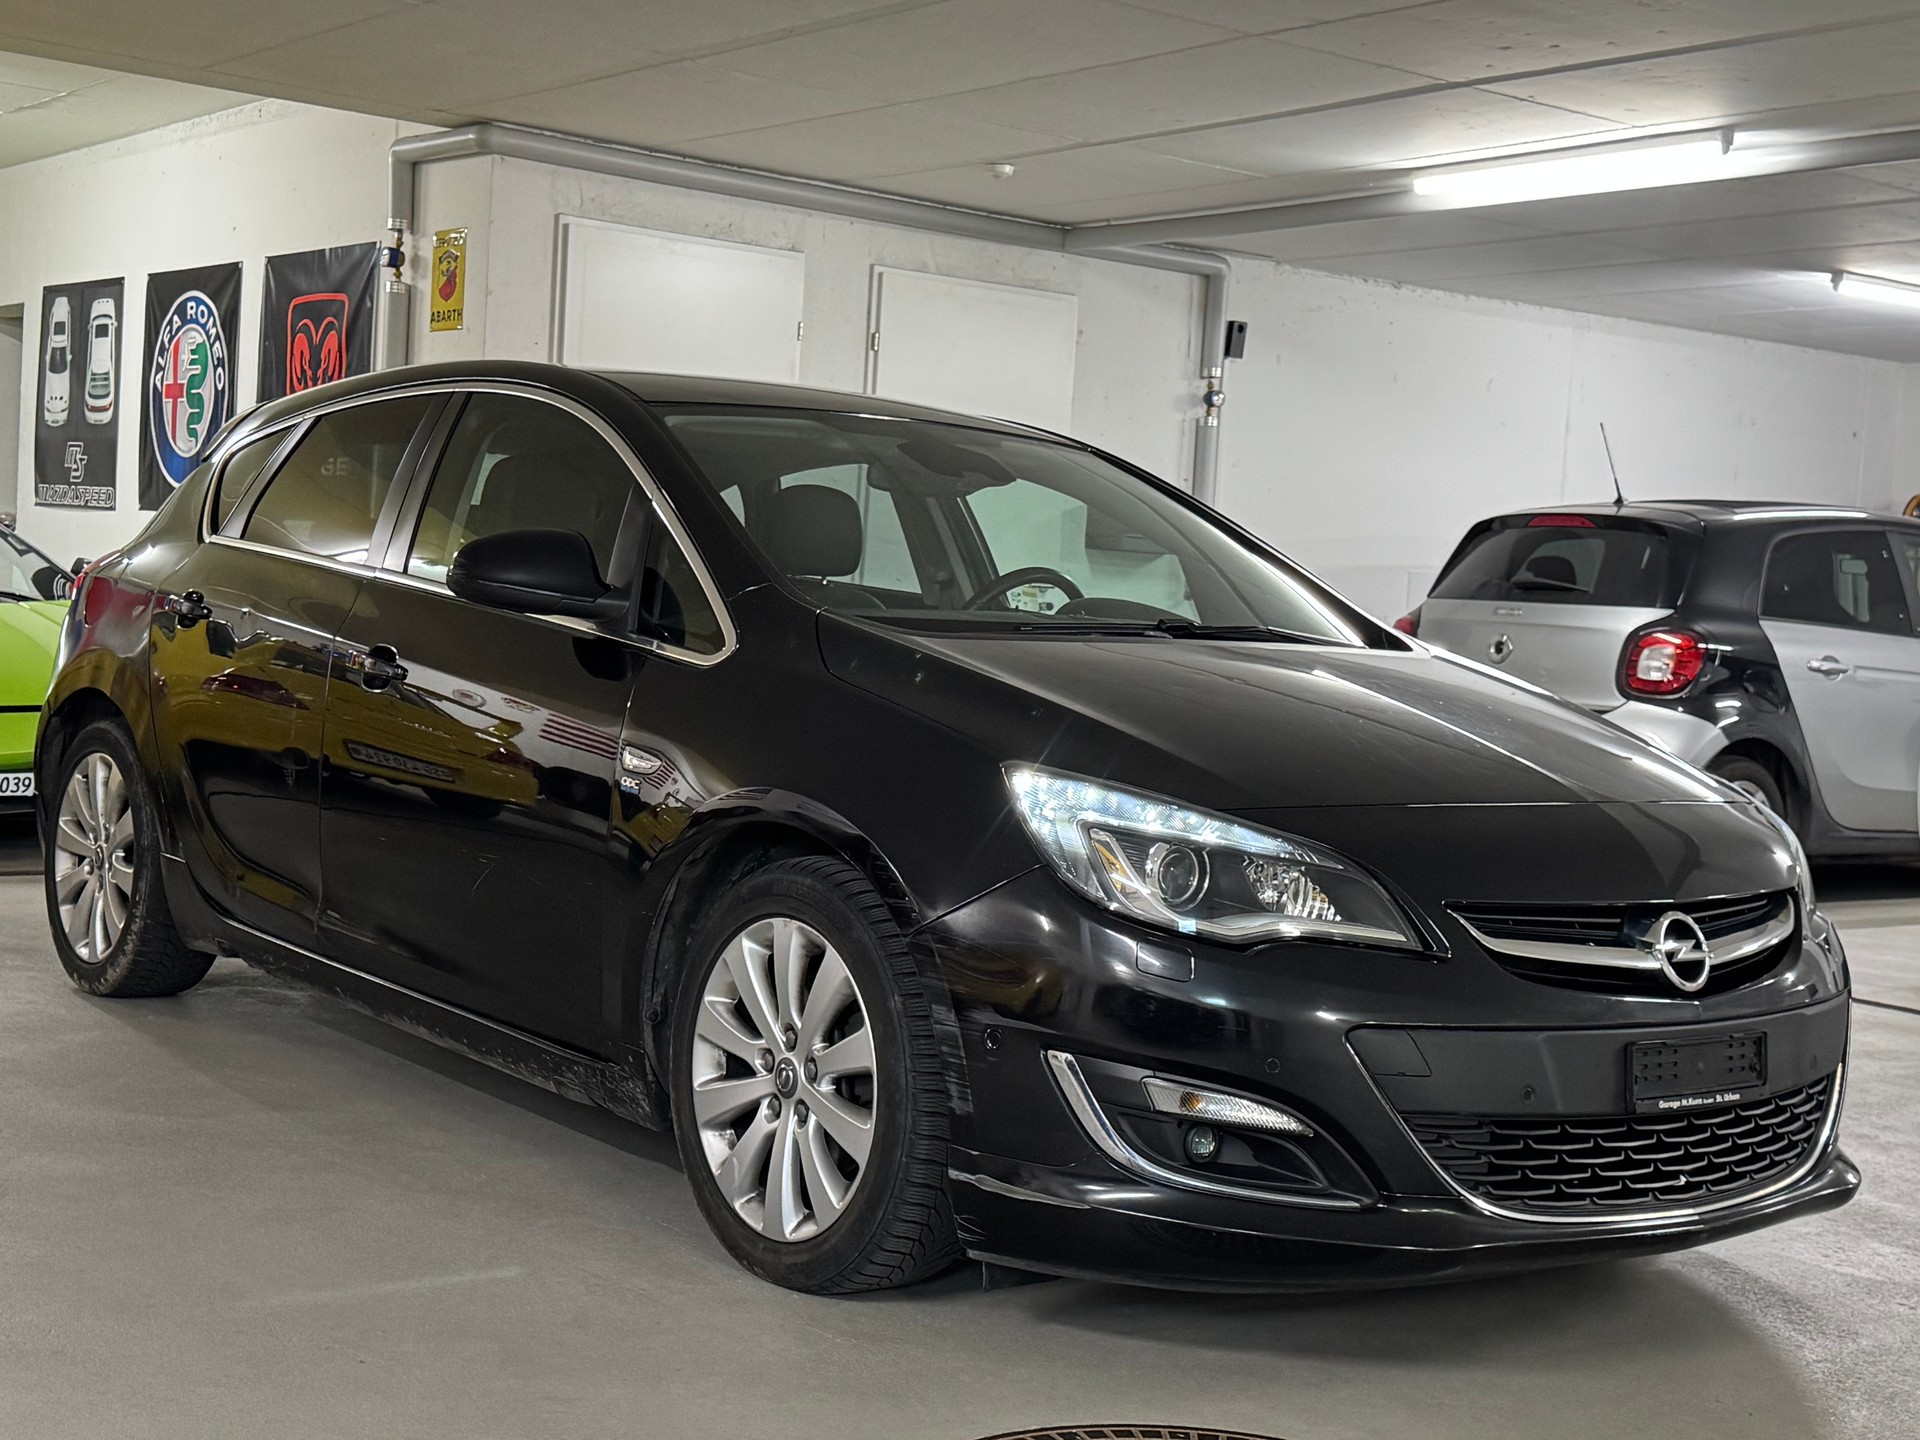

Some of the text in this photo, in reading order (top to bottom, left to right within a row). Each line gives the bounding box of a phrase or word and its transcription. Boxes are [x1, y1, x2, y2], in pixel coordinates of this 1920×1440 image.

[430, 309, 463, 323] ABARTH
[155, 301, 225, 393] ALFA ROMEO
[37, 484, 115, 507] MAZDASPEED
